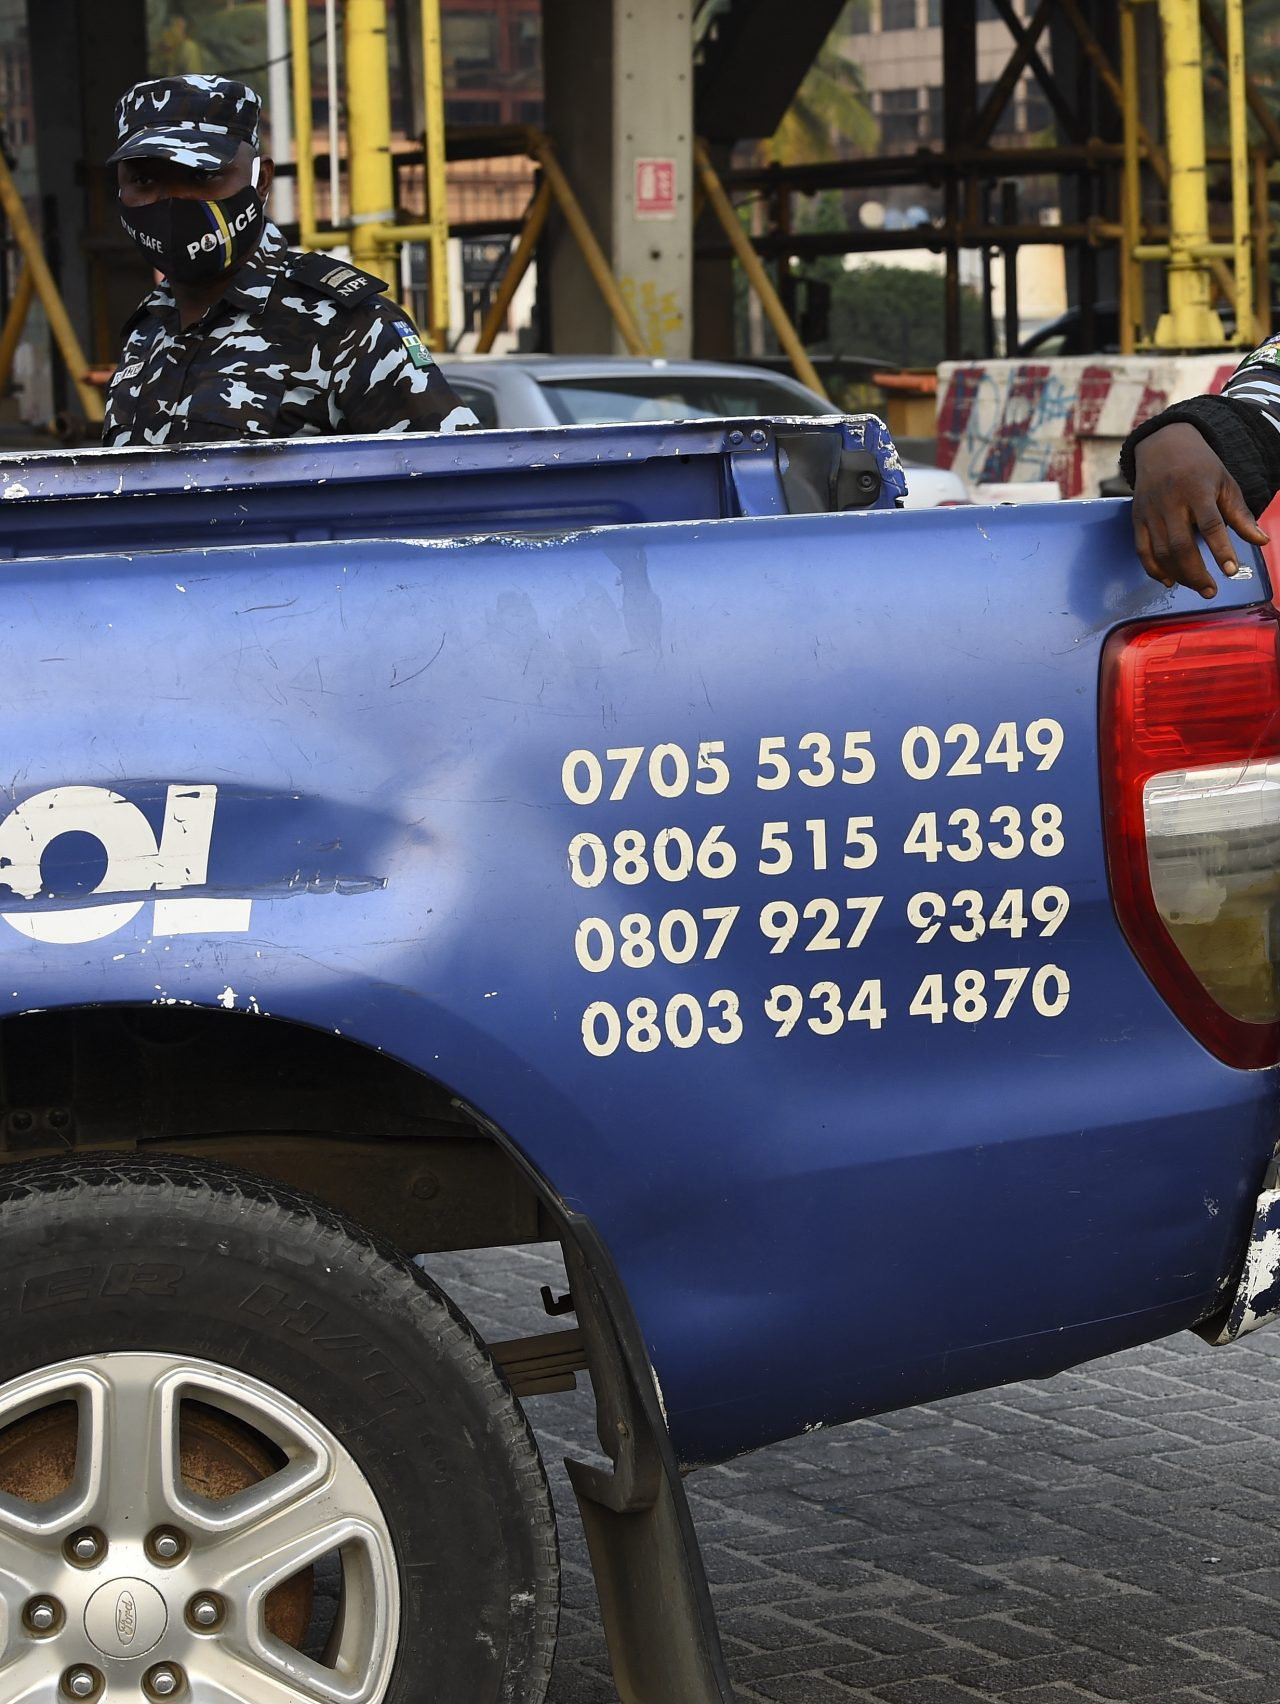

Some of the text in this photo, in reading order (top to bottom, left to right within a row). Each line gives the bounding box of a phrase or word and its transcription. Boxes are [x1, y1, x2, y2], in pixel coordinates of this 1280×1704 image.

[140, 232, 163, 254] SAFE
[187, 203, 257, 260] POLICE
[337, 276, 368, 297] NPF
[562, 719, 1063, 804] 0705 535 0249
[569, 804, 1064, 888] 0806 515 4338
[576, 886, 1069, 972] 0807 927 9349
[582, 964, 1069, 1056] 0803 934 4870
[0, 1262, 185, 1324] ER
[118, 1600, 133, 1635] Ford
